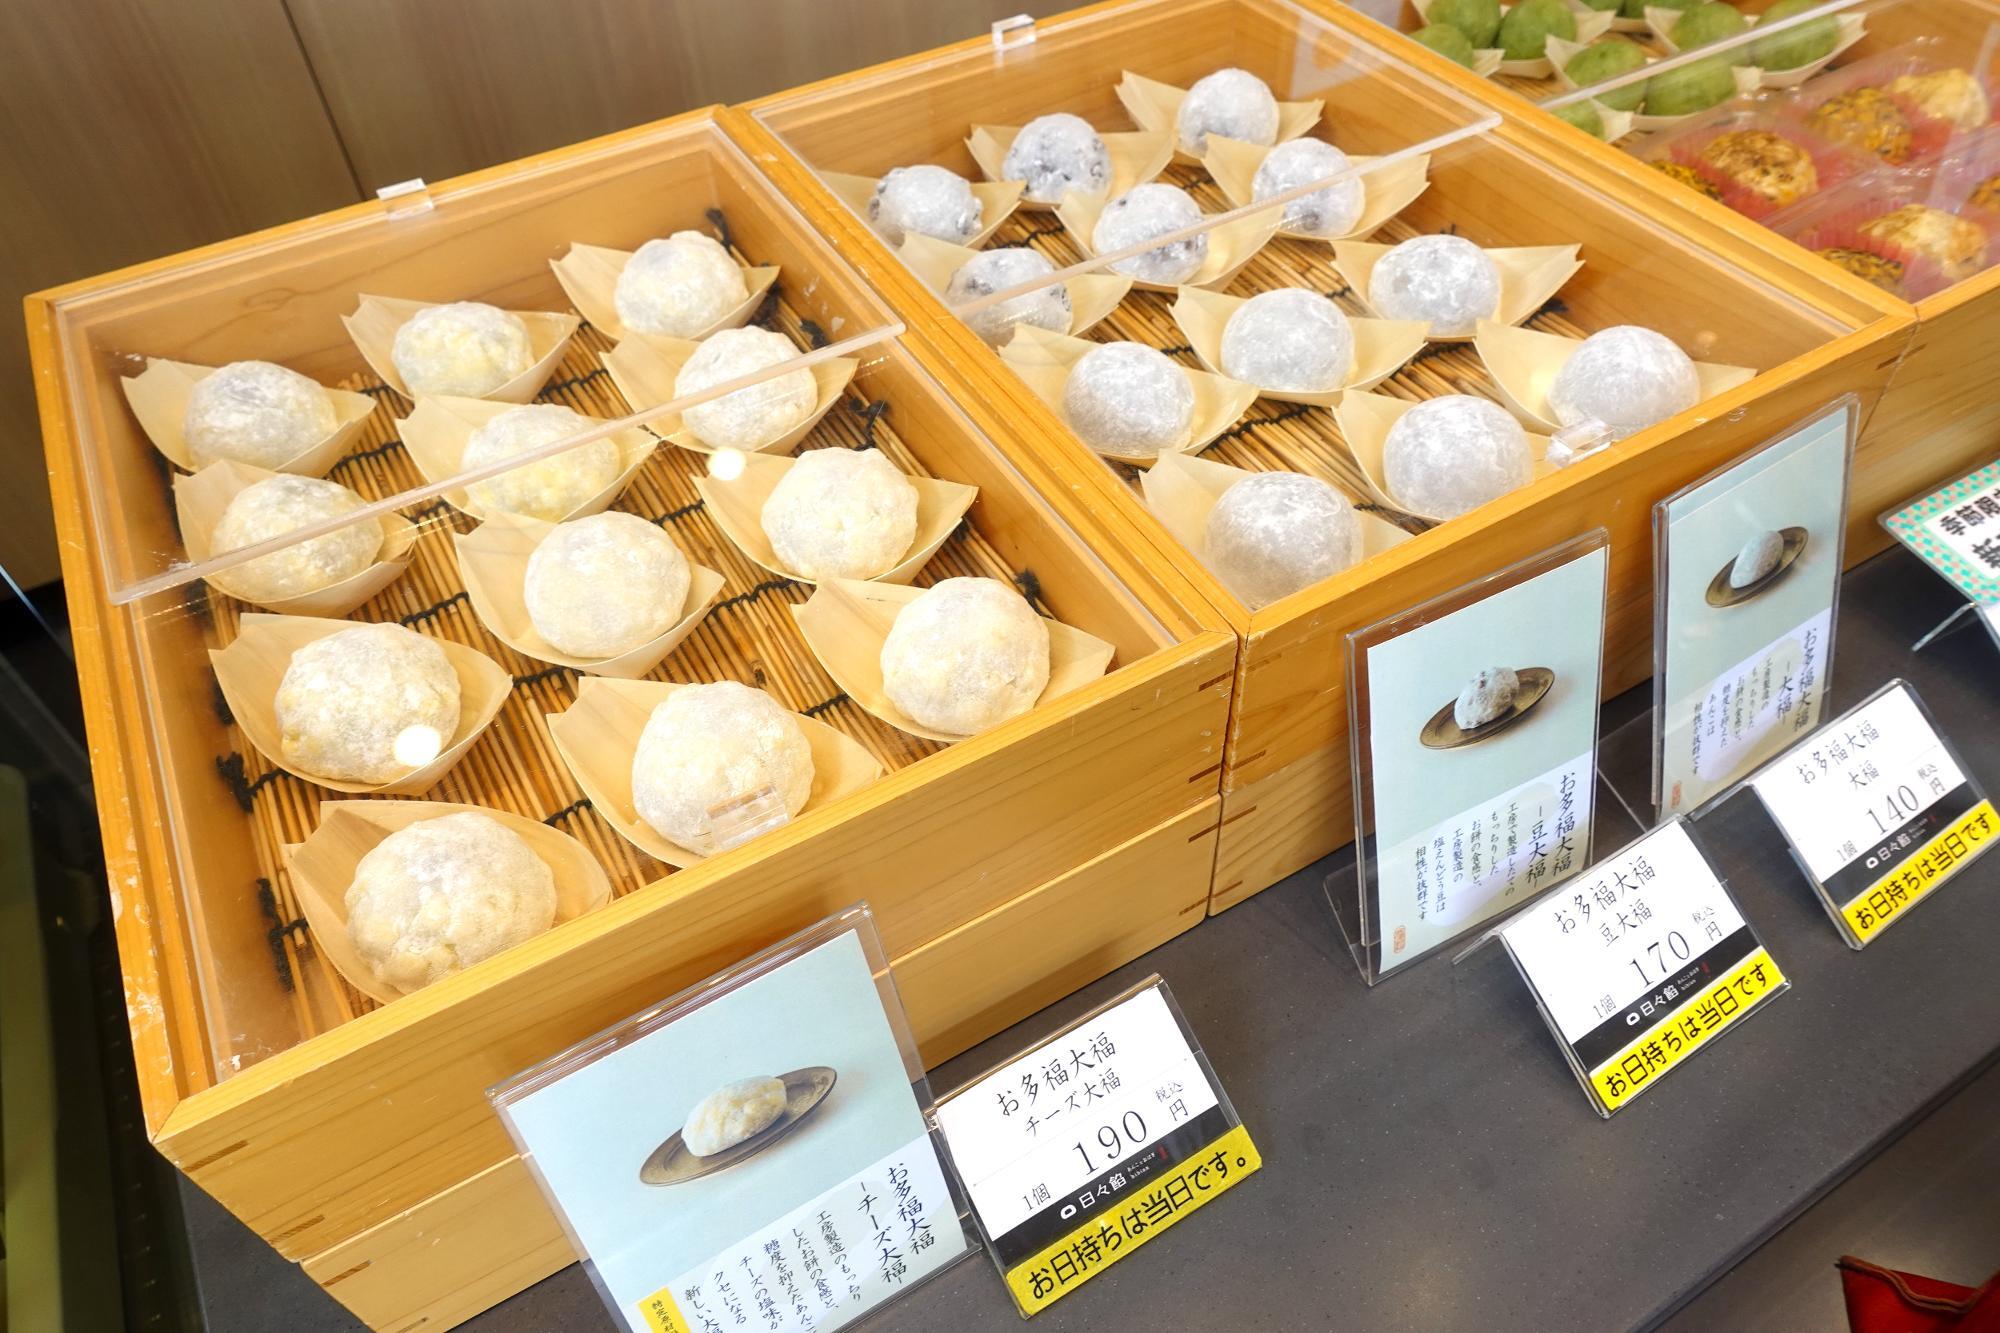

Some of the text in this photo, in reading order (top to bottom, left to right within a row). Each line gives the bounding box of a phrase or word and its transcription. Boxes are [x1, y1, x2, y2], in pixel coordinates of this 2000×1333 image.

[1796, 720, 1880, 785] お多福大福
[1848, 760, 1879, 790] 大福
[1917, 763, 1938, 780] 税込
[1866, 784, 1919, 836] 140
[1930, 777, 1946, 795] 円
[1489, 811, 1500, 876] もっちりした
[1552, 771, 1576, 878] お多福大福
[1836, 840, 1857, 862] 1個
[1415, 845, 1429, 921] 相性が抜群です
[1433, 836, 1446, 913] 塩えんどう豆は
[1553, 855, 1656, 935] お多福大福
[1855, 811, 1992, 930] お日持ちは当日です
[1600, 898, 1653, 948] 豆大福
[1692, 906, 1715, 925] 税込
[1705, 921, 1723, 942] 円
[1628, 930, 1691, 989] 170
[1593, 994, 1617, 1020] 1個
[1639, 984, 1679, 1017] 日々餡
[1605, 962, 1768, 1099] お日持ちは当日です
[996, 1031, 1117, 1116] お多福大福
[1026, 1067, 1122, 1137] チーズ大福
[1155, 1081, 1185, 1103] 税込
[1169, 1100, 1189, 1123] 円
[1072, 1109, 1147, 1177] 190
[888, 1162, 935, 1255] お多福大福
[1023, 1182, 1051, 1211] 1個
[1078, 1171, 1127, 1210] 日々餡
[1027, 1150, 1247, 1301] お日持ちは当日です。
[792, 1228, 840, 1311] したお餅の食感と、
[817, 1210, 861, 1302] 工房製造のもっちり
[651, 1298, 680, 1333] 特定原材
[713, 1271, 748, 1325] クセになる
[739, 1255, 784, 1331] チーズの塩味が
